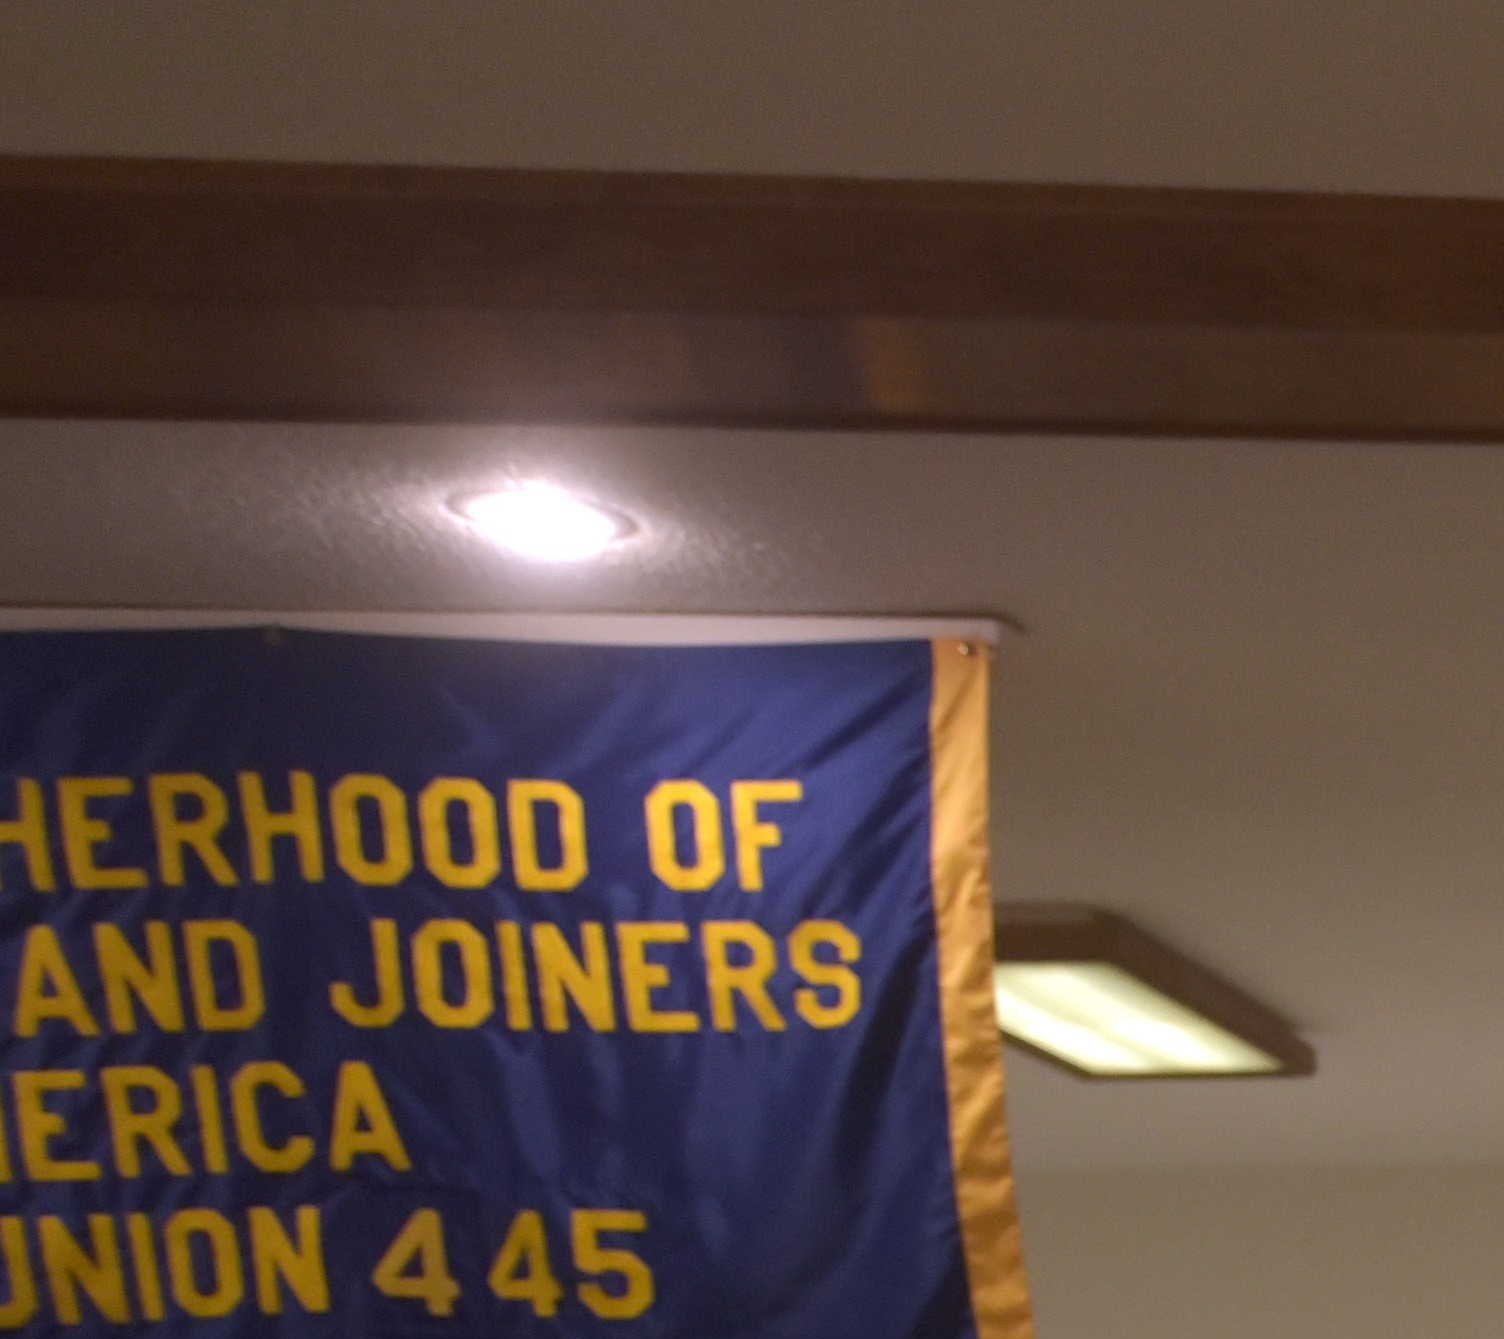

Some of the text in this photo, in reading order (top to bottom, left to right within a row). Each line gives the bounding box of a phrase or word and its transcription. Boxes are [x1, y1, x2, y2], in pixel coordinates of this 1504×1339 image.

[645, 778, 803, 892] OF
[13, 917, 863, 1038] AND JOINERS
